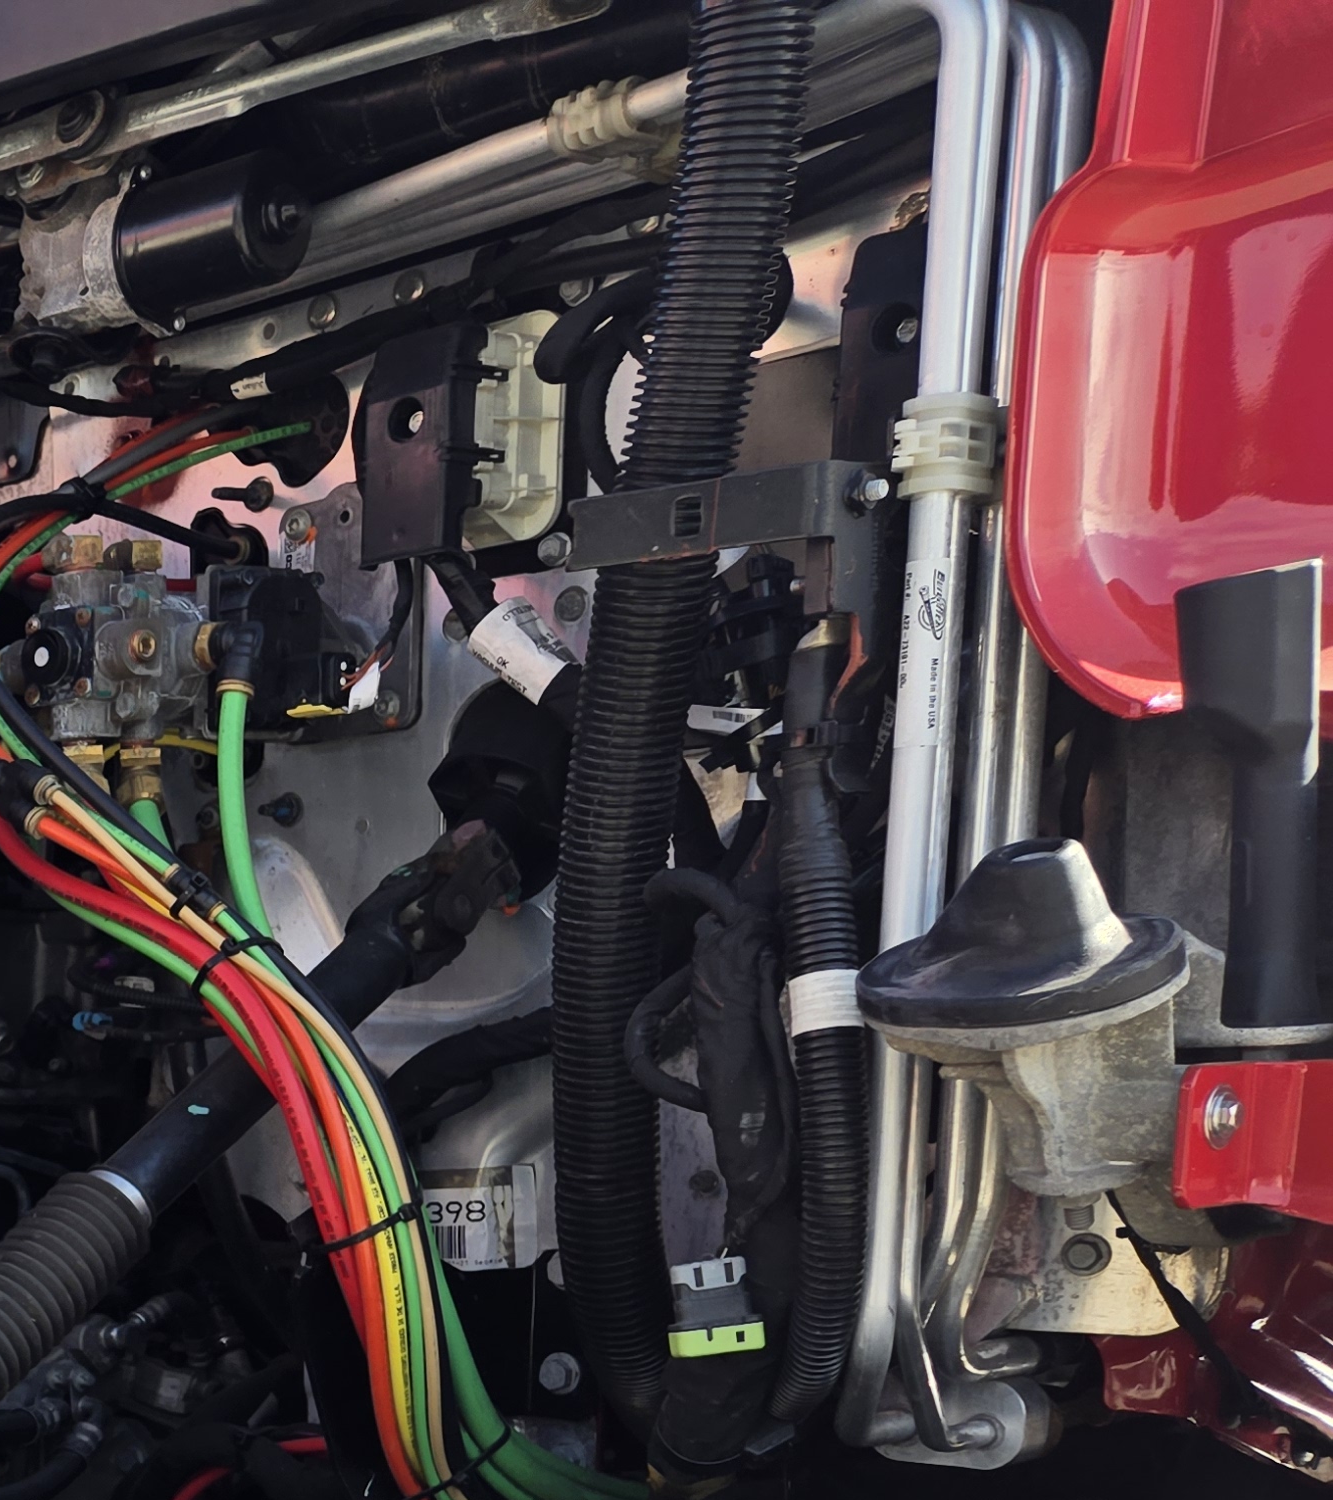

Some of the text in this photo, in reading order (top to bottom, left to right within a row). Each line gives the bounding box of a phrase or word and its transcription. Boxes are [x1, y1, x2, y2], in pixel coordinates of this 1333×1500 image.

[496, 656, 510, 669] OK
[931, 657, 939, 683] Made
[506, 675, 528, 694] TEST
[928, 695, 937, 710] the
[927, 711, 936, 729] USA
